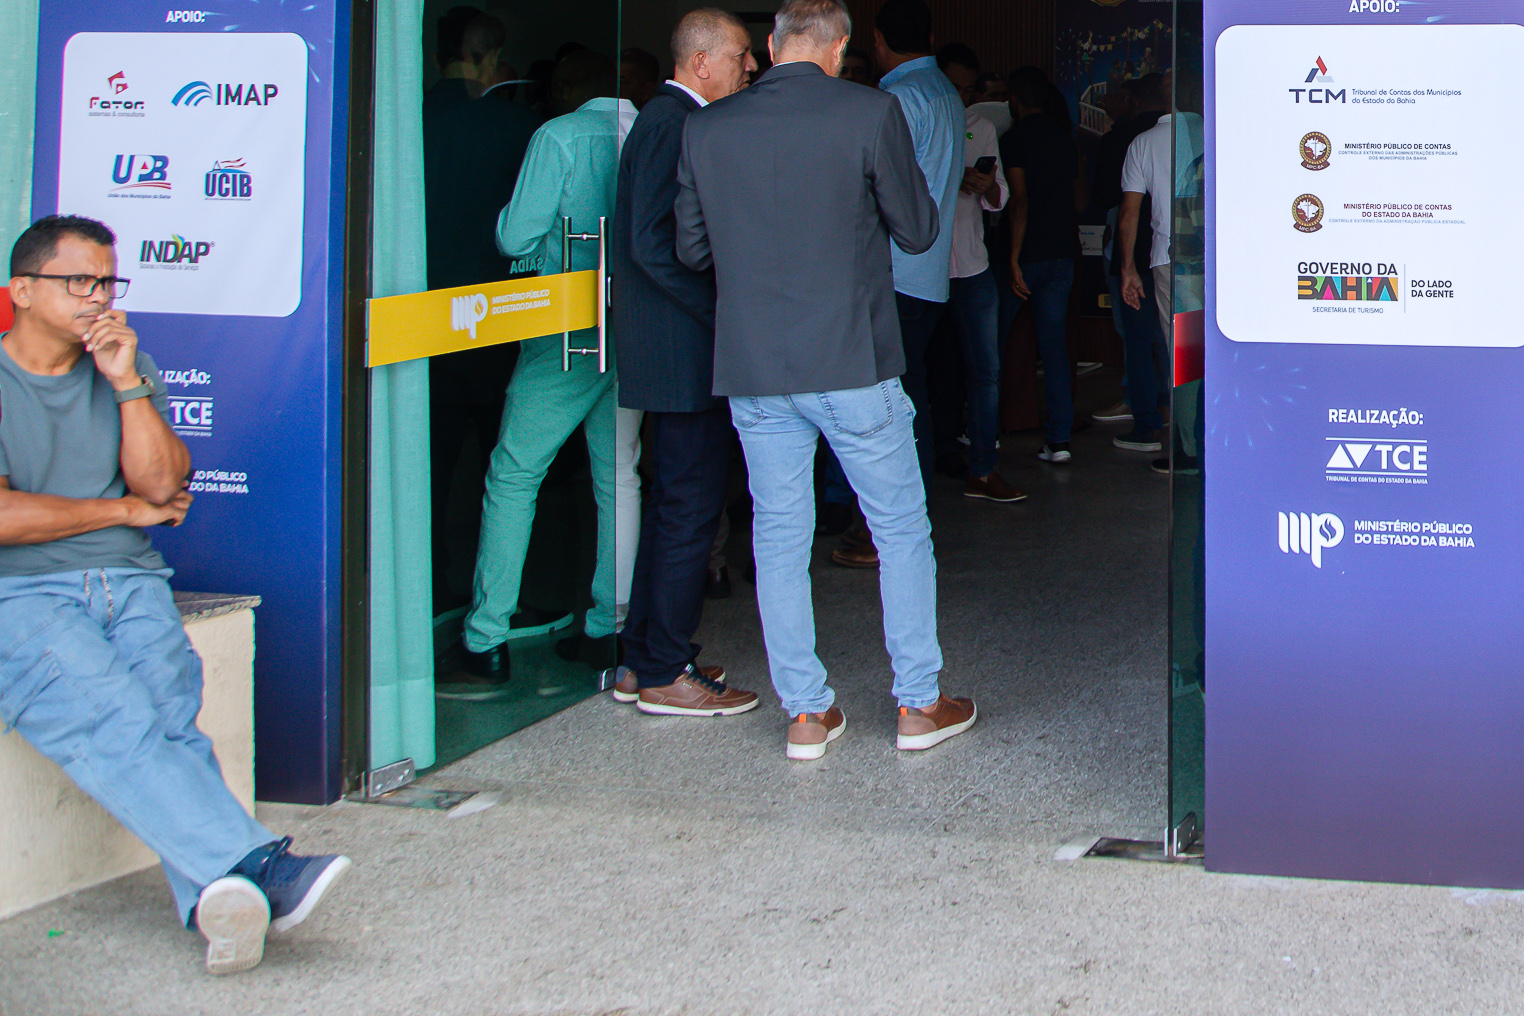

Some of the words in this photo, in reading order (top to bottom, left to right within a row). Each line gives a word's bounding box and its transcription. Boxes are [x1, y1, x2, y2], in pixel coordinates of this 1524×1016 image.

[1349, 0, 1400, 14] APOIO:
[165, 10, 206, 24] APOIO:
[216, 83, 279, 106] IMAP
[1289, 88, 1346, 104] TCM
[1352, 88, 1377, 96] Tribunal
[1426, 88, 1462, 97] Municípios
[1344, 142, 1382, 150] MINISTÉRIO
[1383, 142, 1413, 150] PÚBLICO
[205, 173, 253, 198] UCIB
[1297, 262, 1372, 275] GOVERNO
[1377, 263, 1399, 276] DA
[1297, 275, 1399, 302] BAHIA
[1411, 279, 1426, 288] DO
[1427, 280, 1453, 289] LADO
[1411, 289, 1425, 298] DA
[1425, 290, 1454, 299] GENTE
[158, 368, 213, 388] IZAÇÃO:
[170, 401, 214, 426] TCE
[1328, 407, 1424, 428] REALIZAÇÃO:
[1374, 444, 1428, 471] TCE
[206, 468, 248, 482] PÚBLICO
[205, 482, 219, 493] DA
[219, 482, 250, 494] BAHIA
[1354, 518, 1421, 534] MINISTÉRIO
[1422, 520, 1473, 535] PÚBLICO
[1354, 533, 1372, 545] DO
[1373, 534, 1420, 546] ESTADO
[1421, 535, 1438, 547] DA
[1438, 535, 1475, 548] BAHIA
